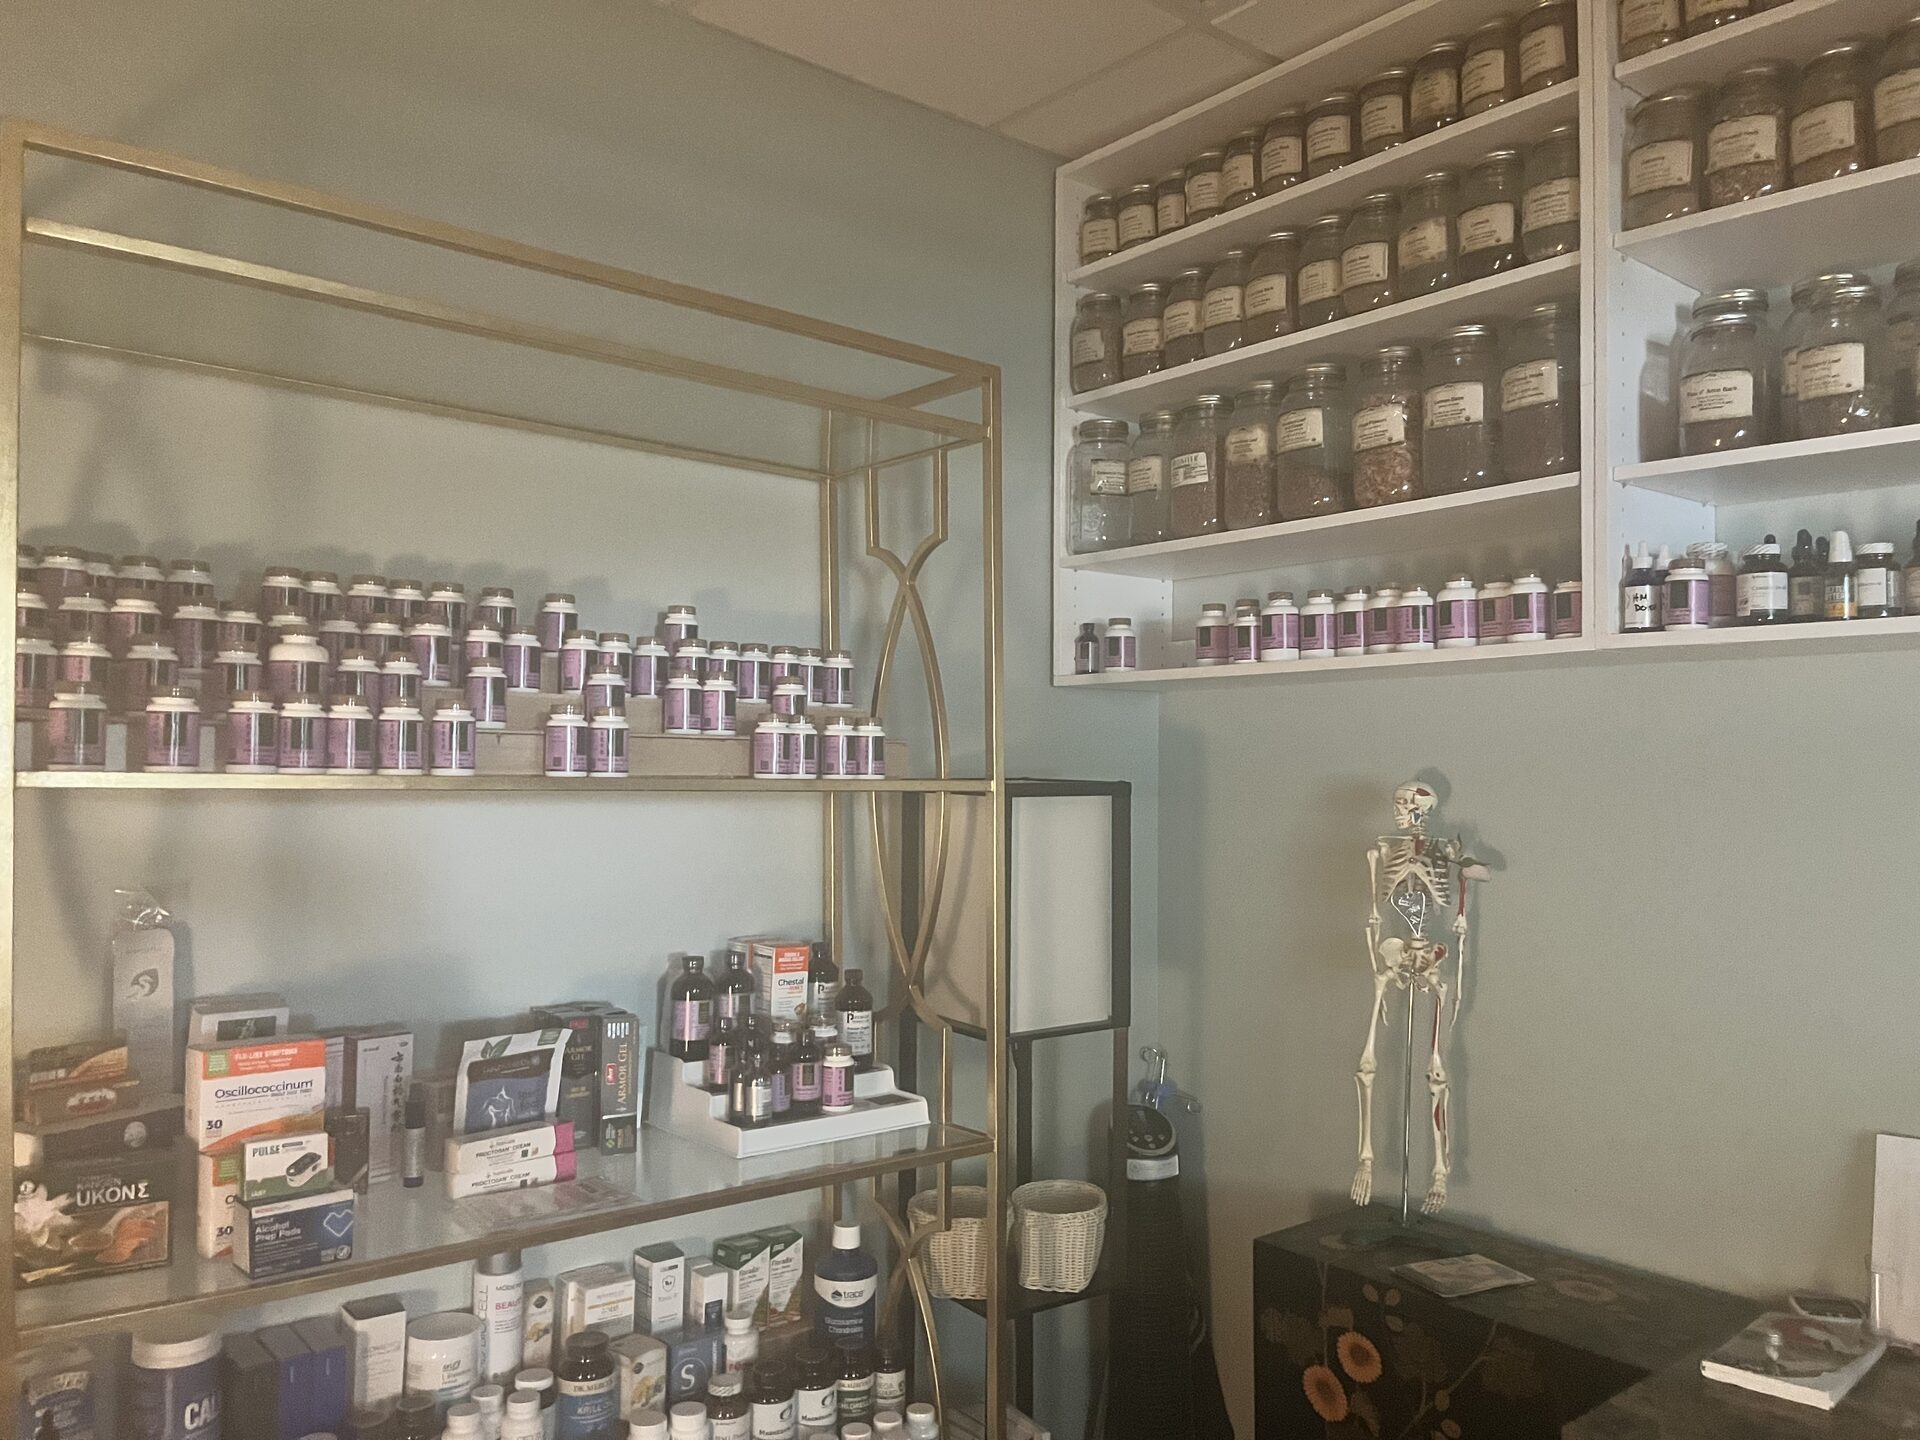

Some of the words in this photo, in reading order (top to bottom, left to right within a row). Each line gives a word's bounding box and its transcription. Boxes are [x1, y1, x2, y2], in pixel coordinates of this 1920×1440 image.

[778, 977, 804, 987] Chestal
[215, 1079, 314, 1099] Oscillococcinum
[617, 1065, 628, 1104] ARMOR
[206, 1119, 223, 1130] 30
[252, 1145, 281, 1158] PULSE
[680, 1363, 695, 1390] S
